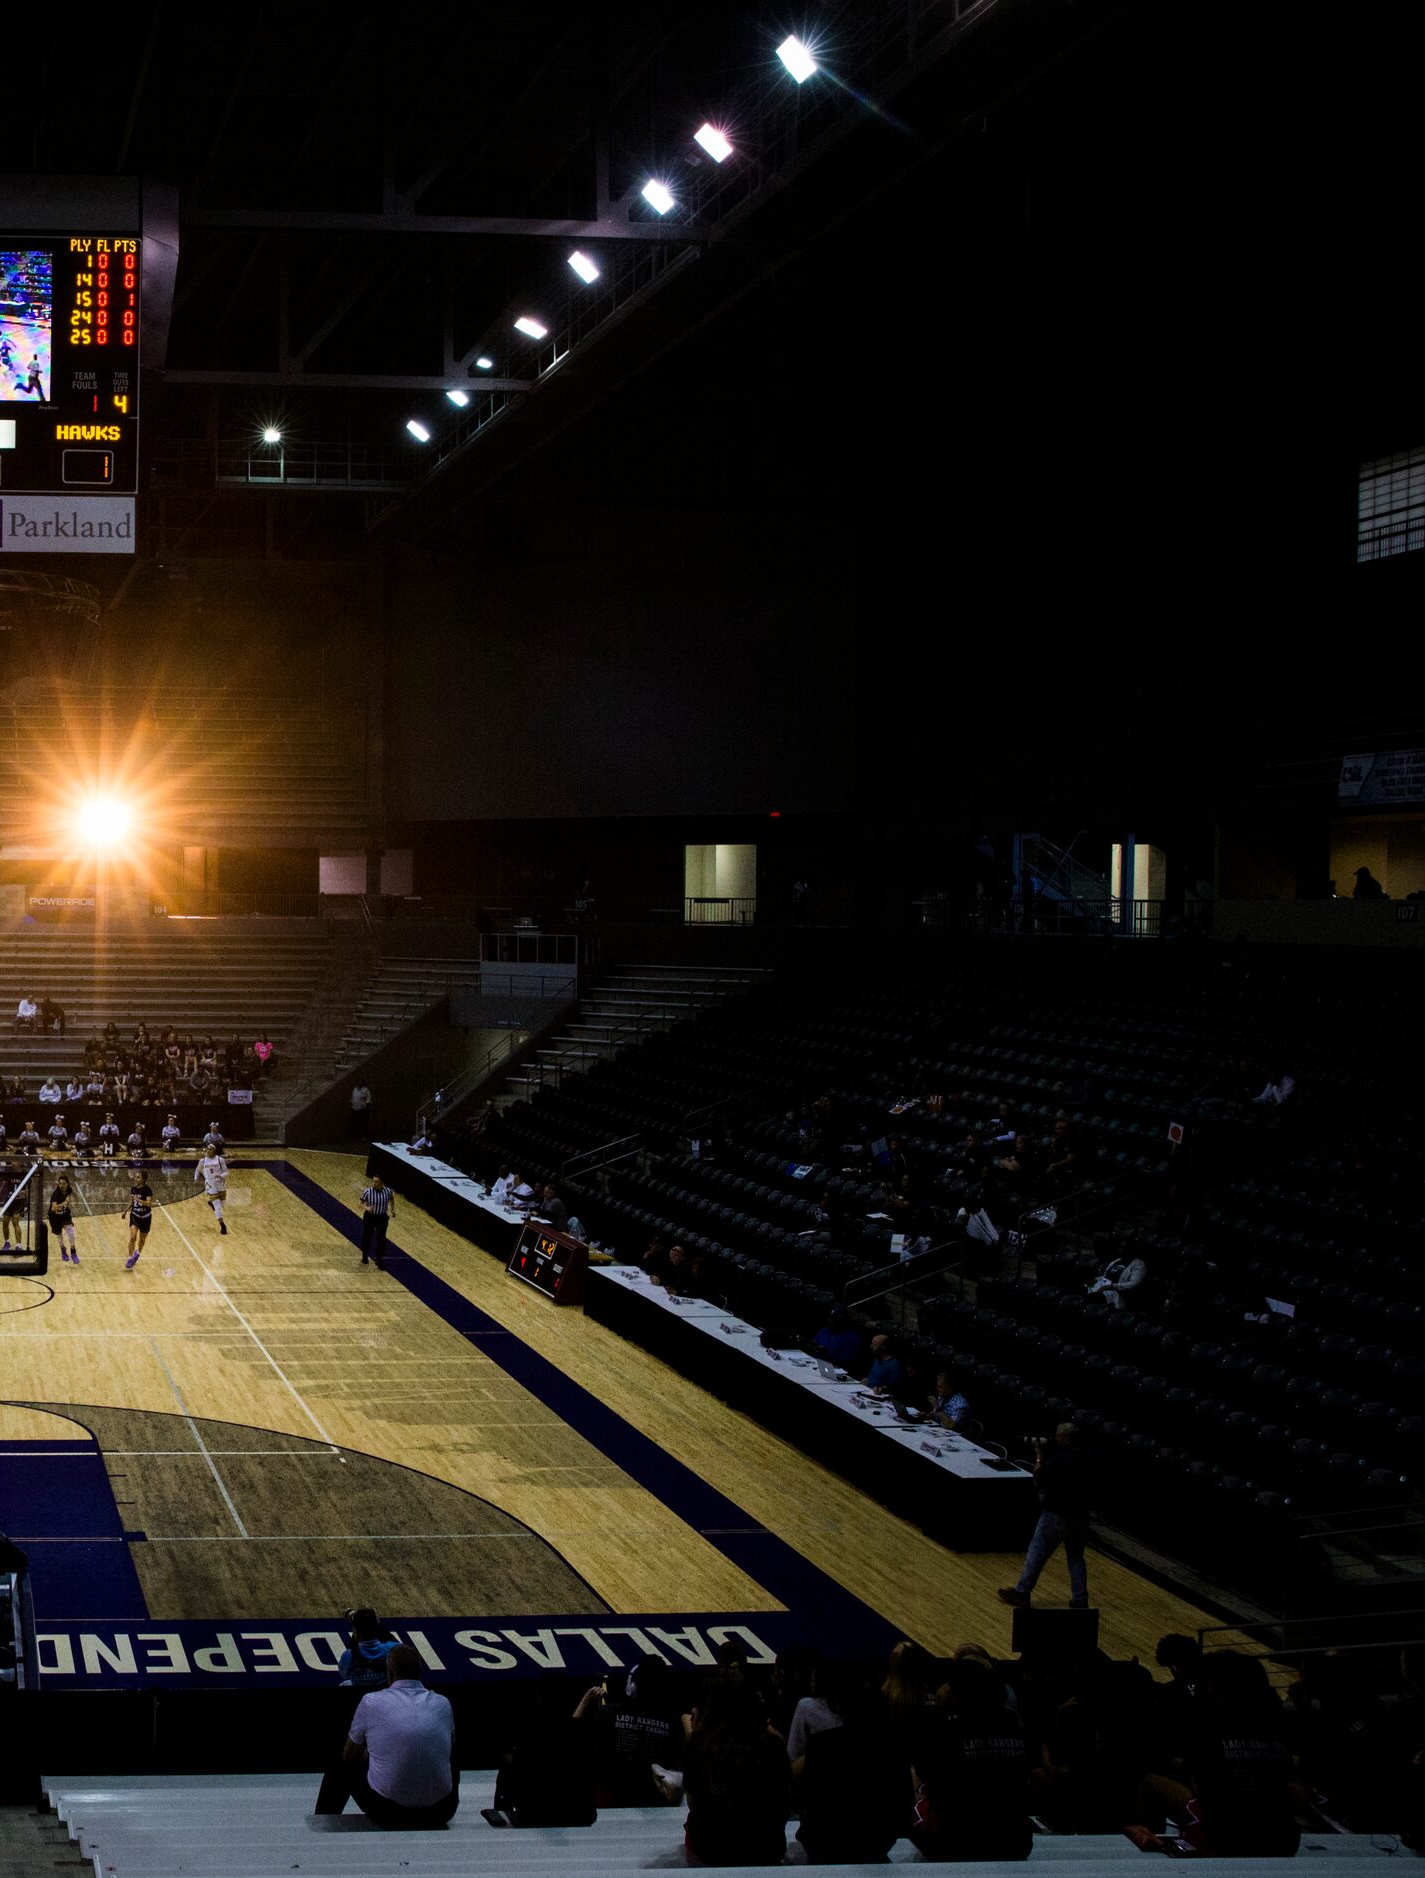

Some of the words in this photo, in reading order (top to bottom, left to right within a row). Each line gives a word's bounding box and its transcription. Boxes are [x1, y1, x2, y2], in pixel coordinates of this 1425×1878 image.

[70, 239, 91, 252] PLY
[96, 239, 111, 252] FL
[114, 240, 137, 252] PTS
[87, 254, 92, 268] 1
[98, 253, 108, 268] 0
[124, 254, 134, 269] 0
[76, 272, 92, 287] 14
[98, 272, 108, 287] 0
[124, 273, 134, 288] 0
[76, 291, 92, 307] 15
[98, 291, 108, 306] 0
[129, 293, 134, 306] 1
[71, 310, 92, 325] 24
[97, 310, 107, 325] 0
[123, 311, 133, 326] 0
[70, 329, 91, 345] 25
[97, 329, 107, 344] 0
[123, 330, 133, 345] 0
[74, 371, 96, 381] TEAM
[113, 372, 129, 380] TIME
[72, 380, 98, 390] FOULS
[93, 394, 98, 413] 1
[114, 394, 128, 414] 4
[55, 425, 121, 440] HAWKS
[104, 456, 109, 479] 1
[8, 512, 132, 539] Parkland
[29, 897, 95, 906] POWERADE
[154, 906, 167, 914] 104
[1397, 905, 1415, 920] 107
[453, 1625, 780, 1670] DALLAS
[614, 1721, 644, 1731] DISTRICT
[645, 1726, 671, 1737] CHAMPS
[616, 1713, 635, 1723] LADY
[636, 1716, 670, 1730] RANGERS
